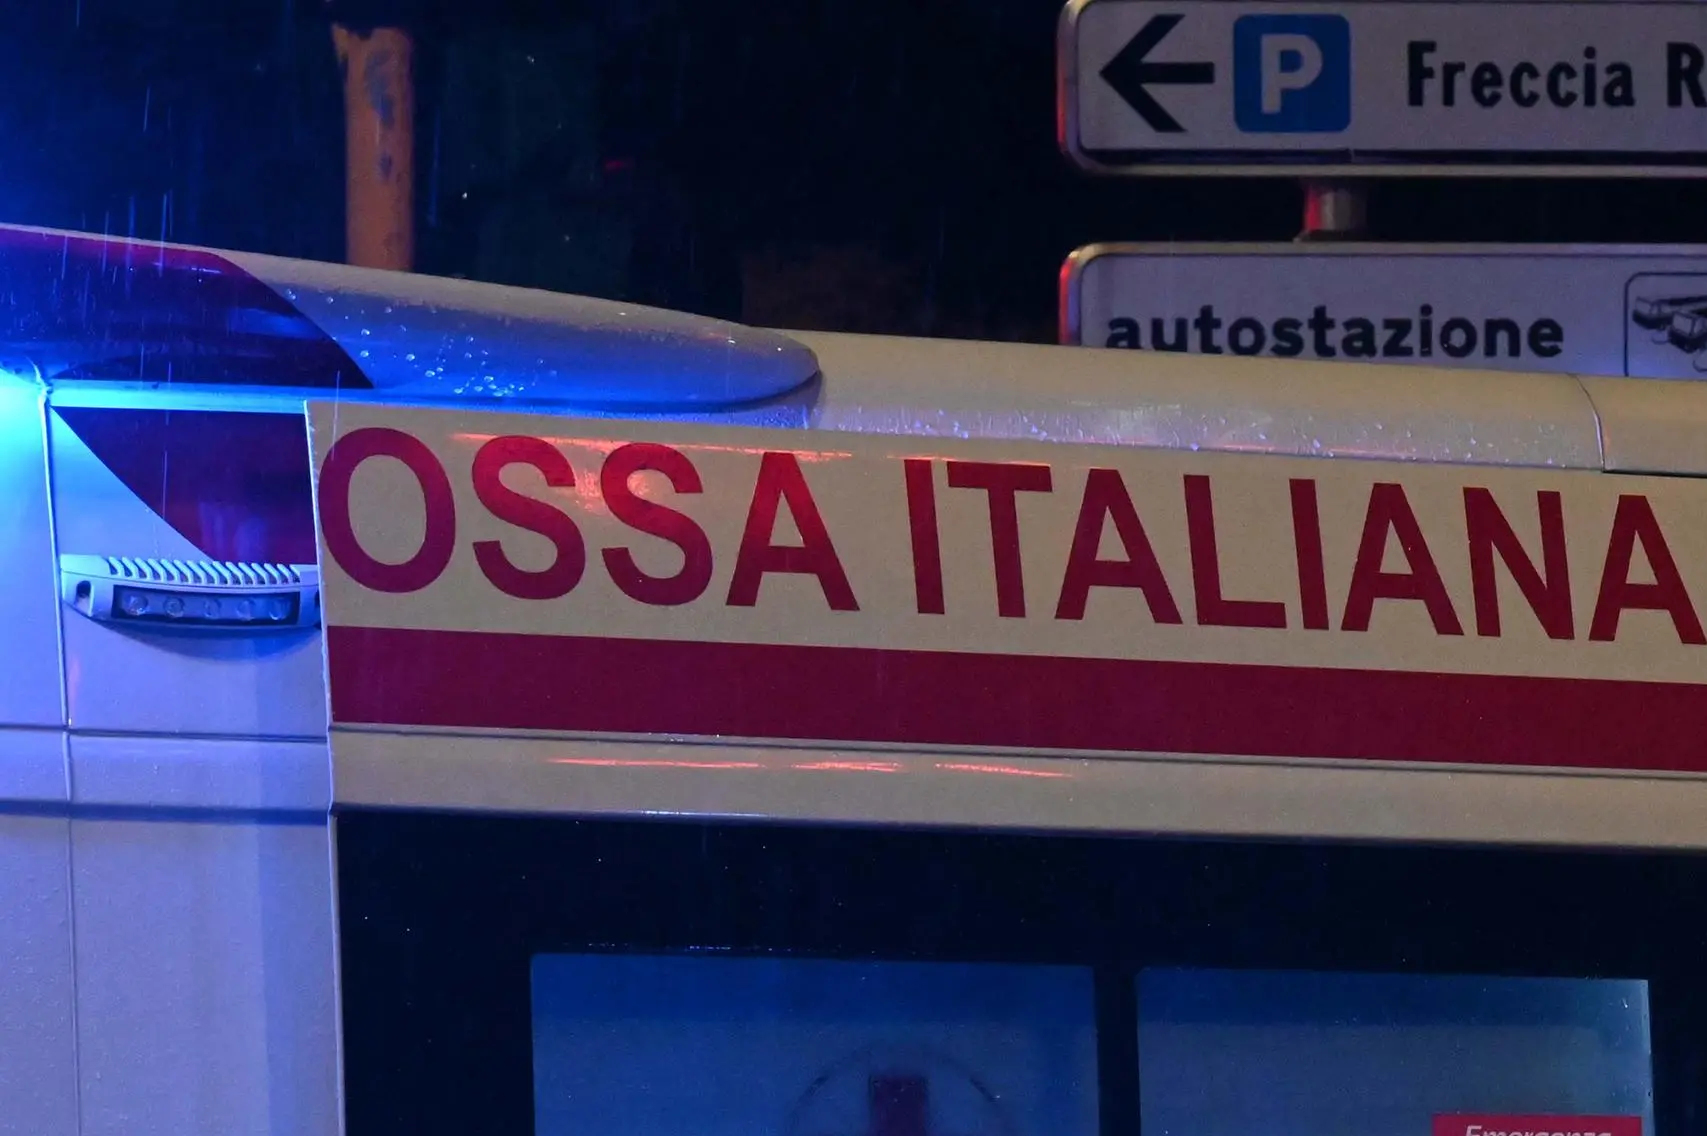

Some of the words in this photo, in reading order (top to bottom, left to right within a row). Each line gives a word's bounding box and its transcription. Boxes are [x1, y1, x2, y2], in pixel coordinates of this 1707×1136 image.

[1259, 33, 1324, 115] P
[1406, 41, 1635, 109] Freccia
[1105, 304, 1565, 358] autostazione
[317, 427, 861, 613] OSSA
